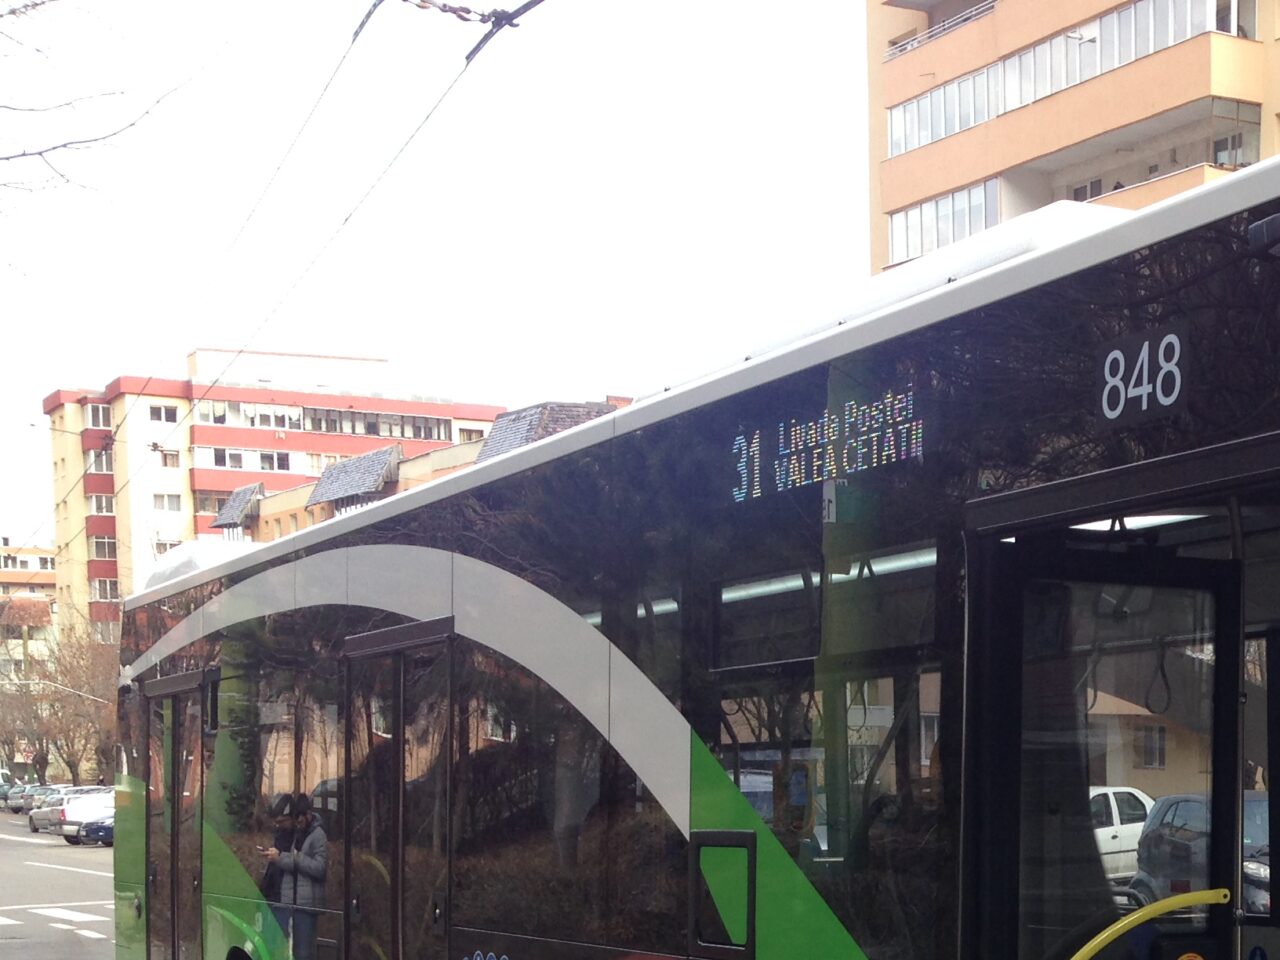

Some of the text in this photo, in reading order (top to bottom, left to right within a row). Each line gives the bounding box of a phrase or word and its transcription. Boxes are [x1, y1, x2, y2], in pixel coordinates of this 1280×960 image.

[1102, 333, 1182, 420] 848
[779, 409, 839, 455] Livada
[732, 430, 761, 502] 31
[775, 445, 837, 492] VALEA
